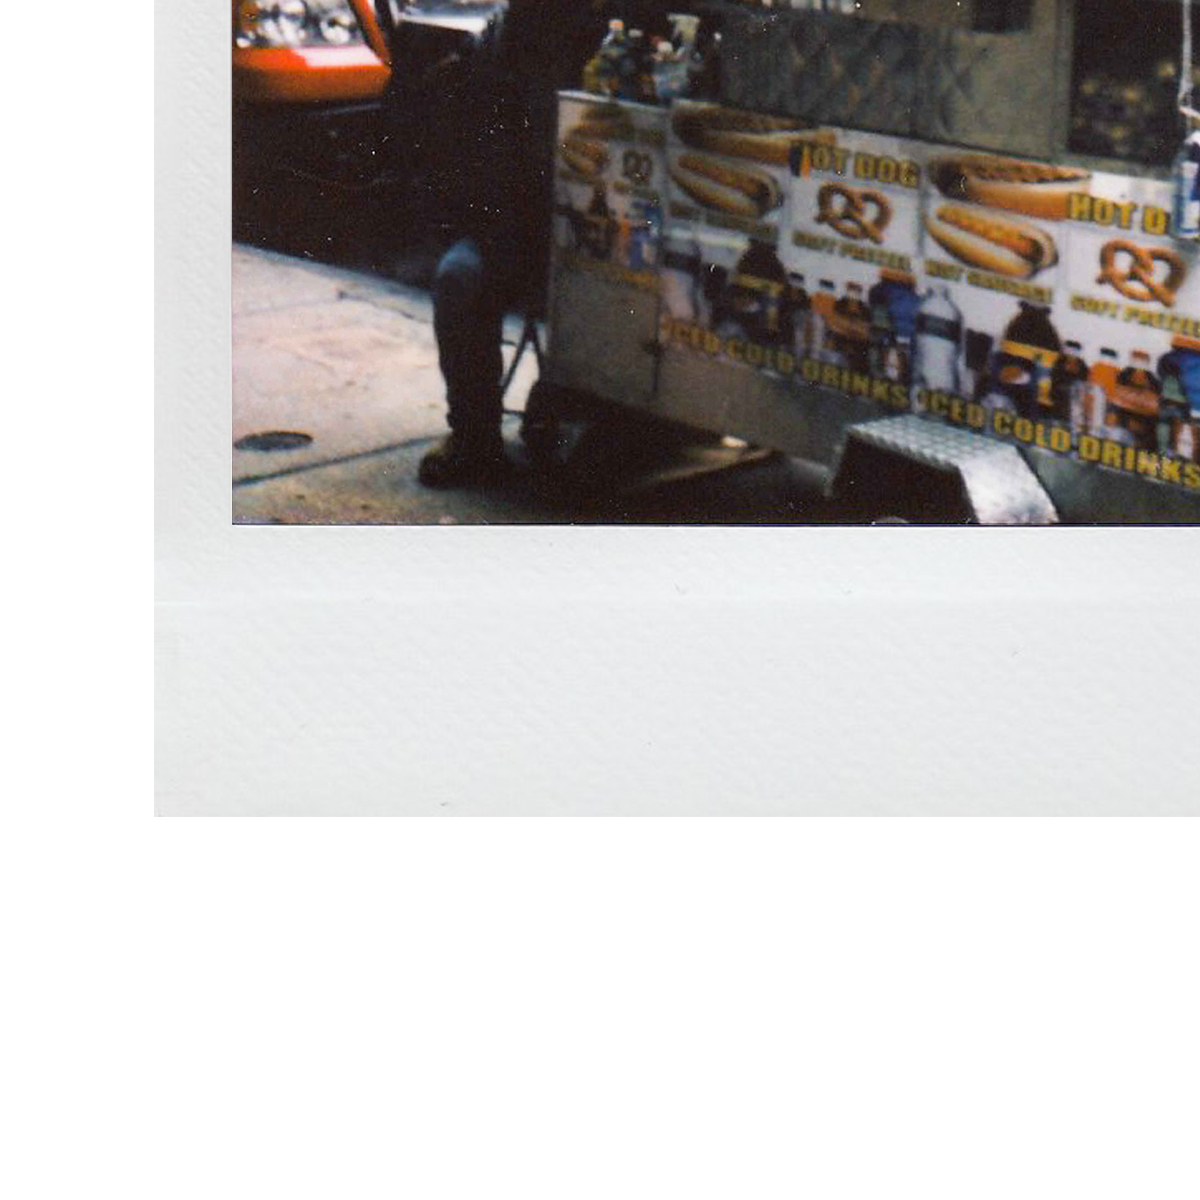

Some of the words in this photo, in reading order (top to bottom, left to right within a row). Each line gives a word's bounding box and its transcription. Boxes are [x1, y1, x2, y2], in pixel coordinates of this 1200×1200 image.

[1068, 193, 1138, 228] HOT
[803, 357, 908, 409] DRINKS
[994, 411, 1071, 451] COLD
